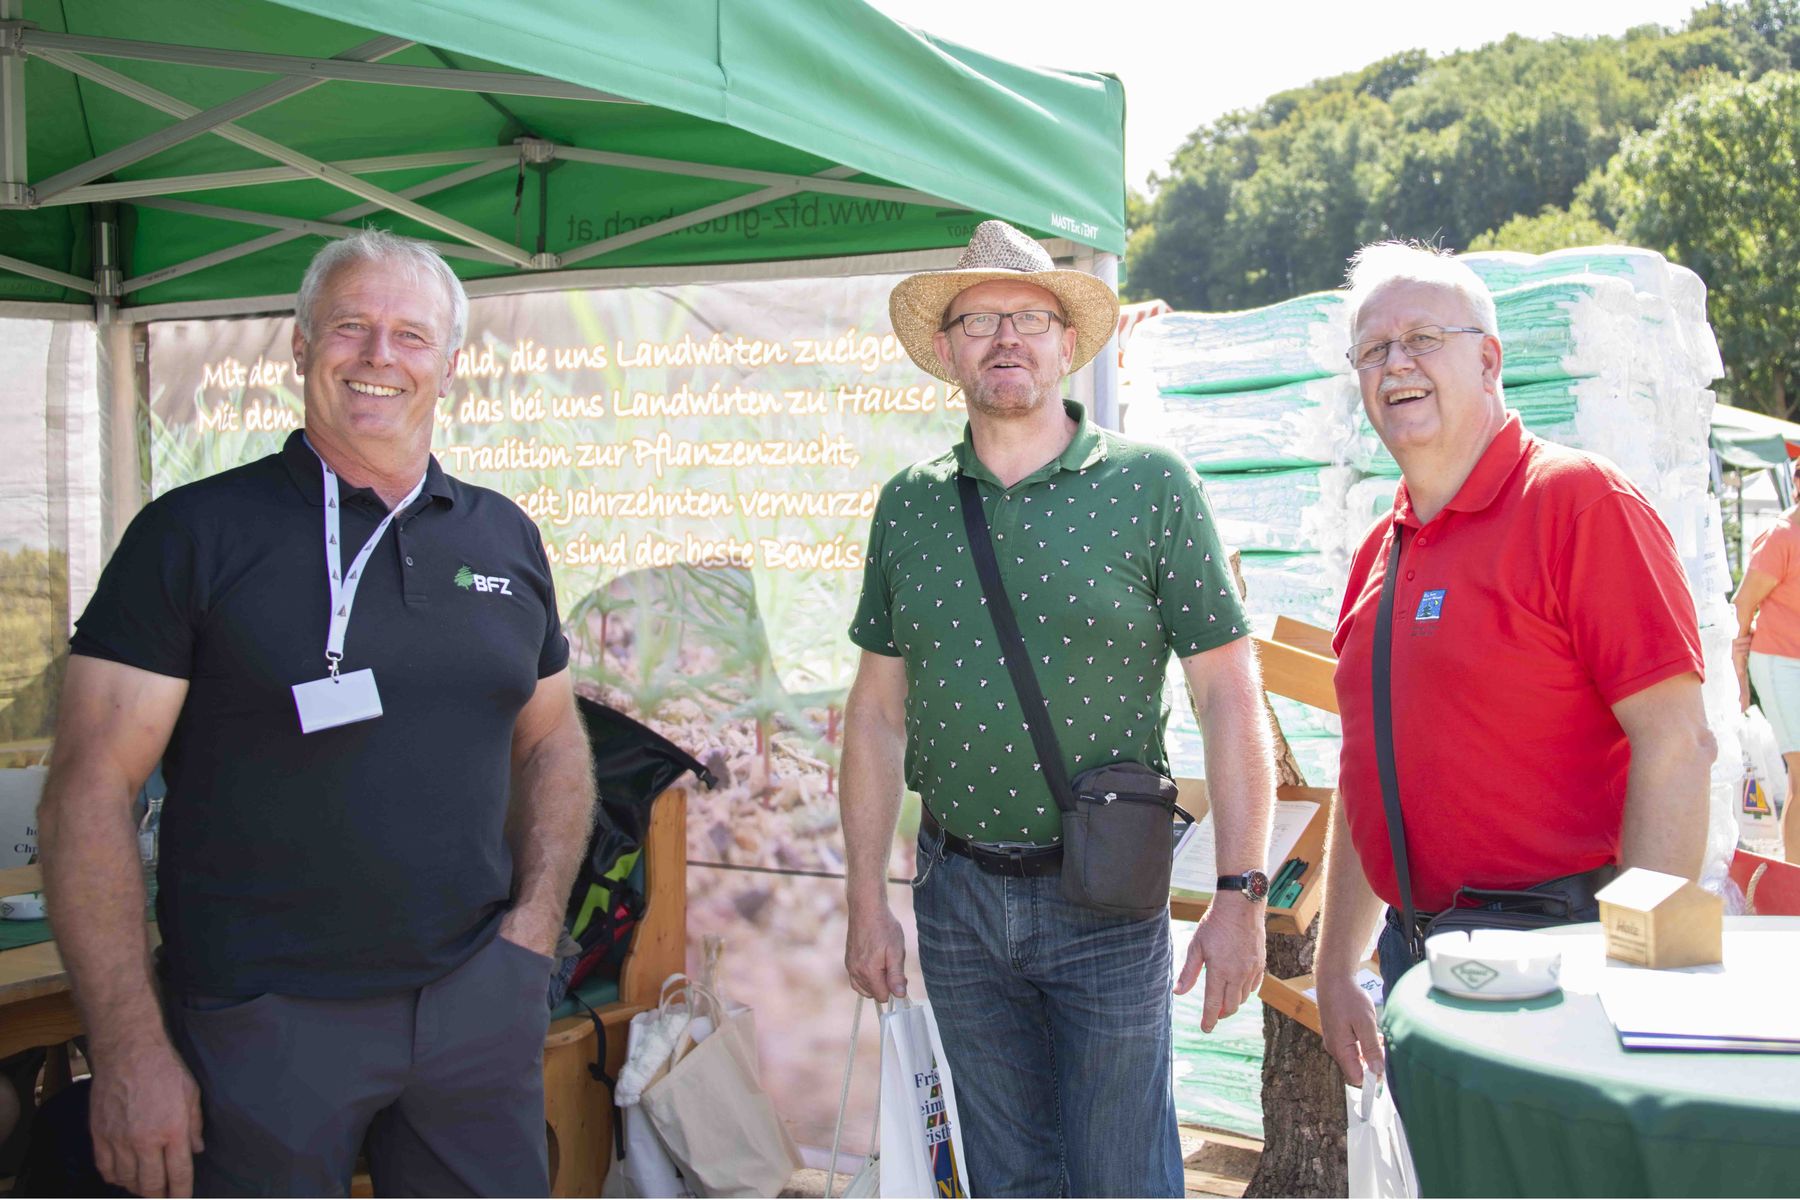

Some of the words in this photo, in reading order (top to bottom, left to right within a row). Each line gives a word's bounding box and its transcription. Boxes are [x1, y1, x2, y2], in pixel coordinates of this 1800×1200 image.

[201, 357, 247, 389] Mit
[249, 354, 288, 388] der
[511, 340, 549, 373] die
[555, 345, 607, 369] uns
[617, 333, 787, 367] Landwirten
[198, 403, 239, 432] Mit
[245, 399, 299, 431] dem
[460, 393, 505, 423] das
[510, 389, 545, 420] bei
[552, 394, 604, 418] uns
[613, 382, 782, 417] Landwirten
[784, 391, 827, 415] zu
[837, 384, 936, 413] Hause
[449, 439, 571, 472] Tradition
[575, 444, 627, 467] zur
[632, 431, 861, 480] Pflanzenzucht,
[515, 485, 561, 519] seit
[553, 483, 734, 526] Jahrzehnten
[565, 531, 628, 566] sind
[634, 531, 680, 567] der
[686, 531, 755, 569] beste
[472, 573, 513, 596] BFZ
